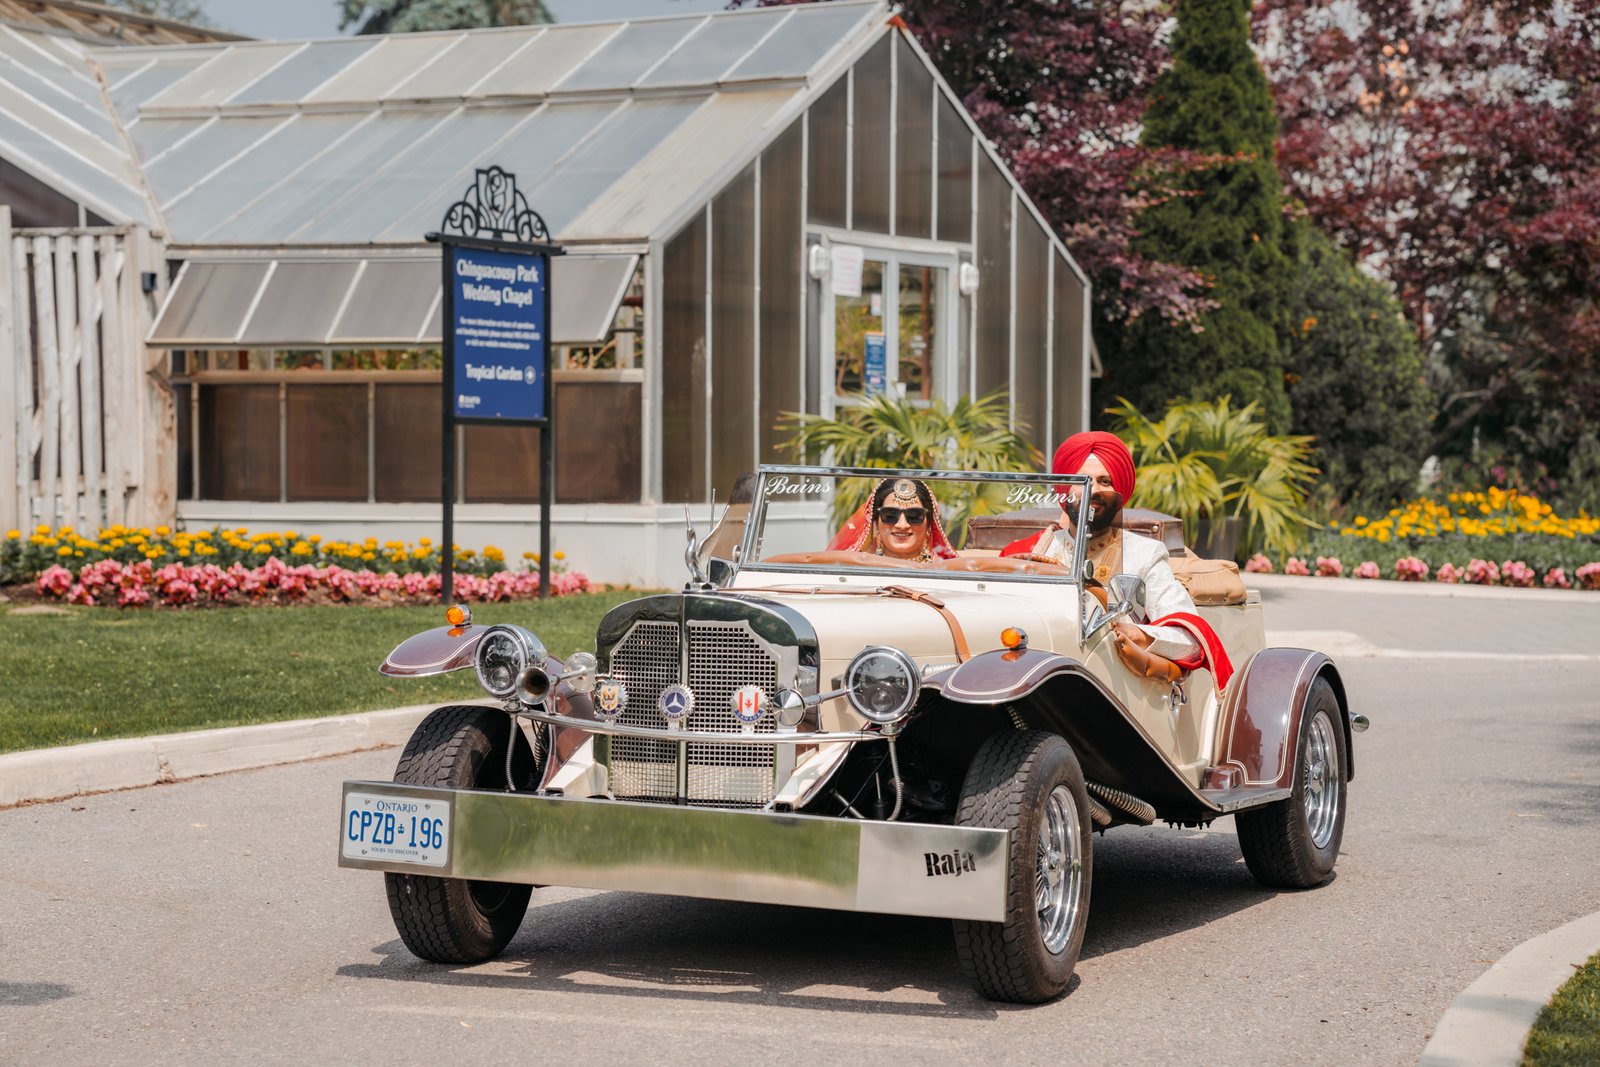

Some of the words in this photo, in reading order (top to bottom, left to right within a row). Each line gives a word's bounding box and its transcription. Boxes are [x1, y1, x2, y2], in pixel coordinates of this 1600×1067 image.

[456, 258, 517, 284] Chinguacousy
[517, 264, 539, 283] Park
[462, 283, 501, 306] Wedding
[502, 286, 533, 308] Chapel
[465, 363, 496, 381] Tropical
[496, 365, 523, 381] Garden
[764, 476, 831, 494] Bains
[1006, 484, 1077, 504] Bains
[735, 708, 764, 722] CANADA
[376, 800, 418, 813] ONTARIO
[348, 810, 396, 845] CPZB
[409, 816, 443, 849] 196
[923, 849, 977, 877] Raja
